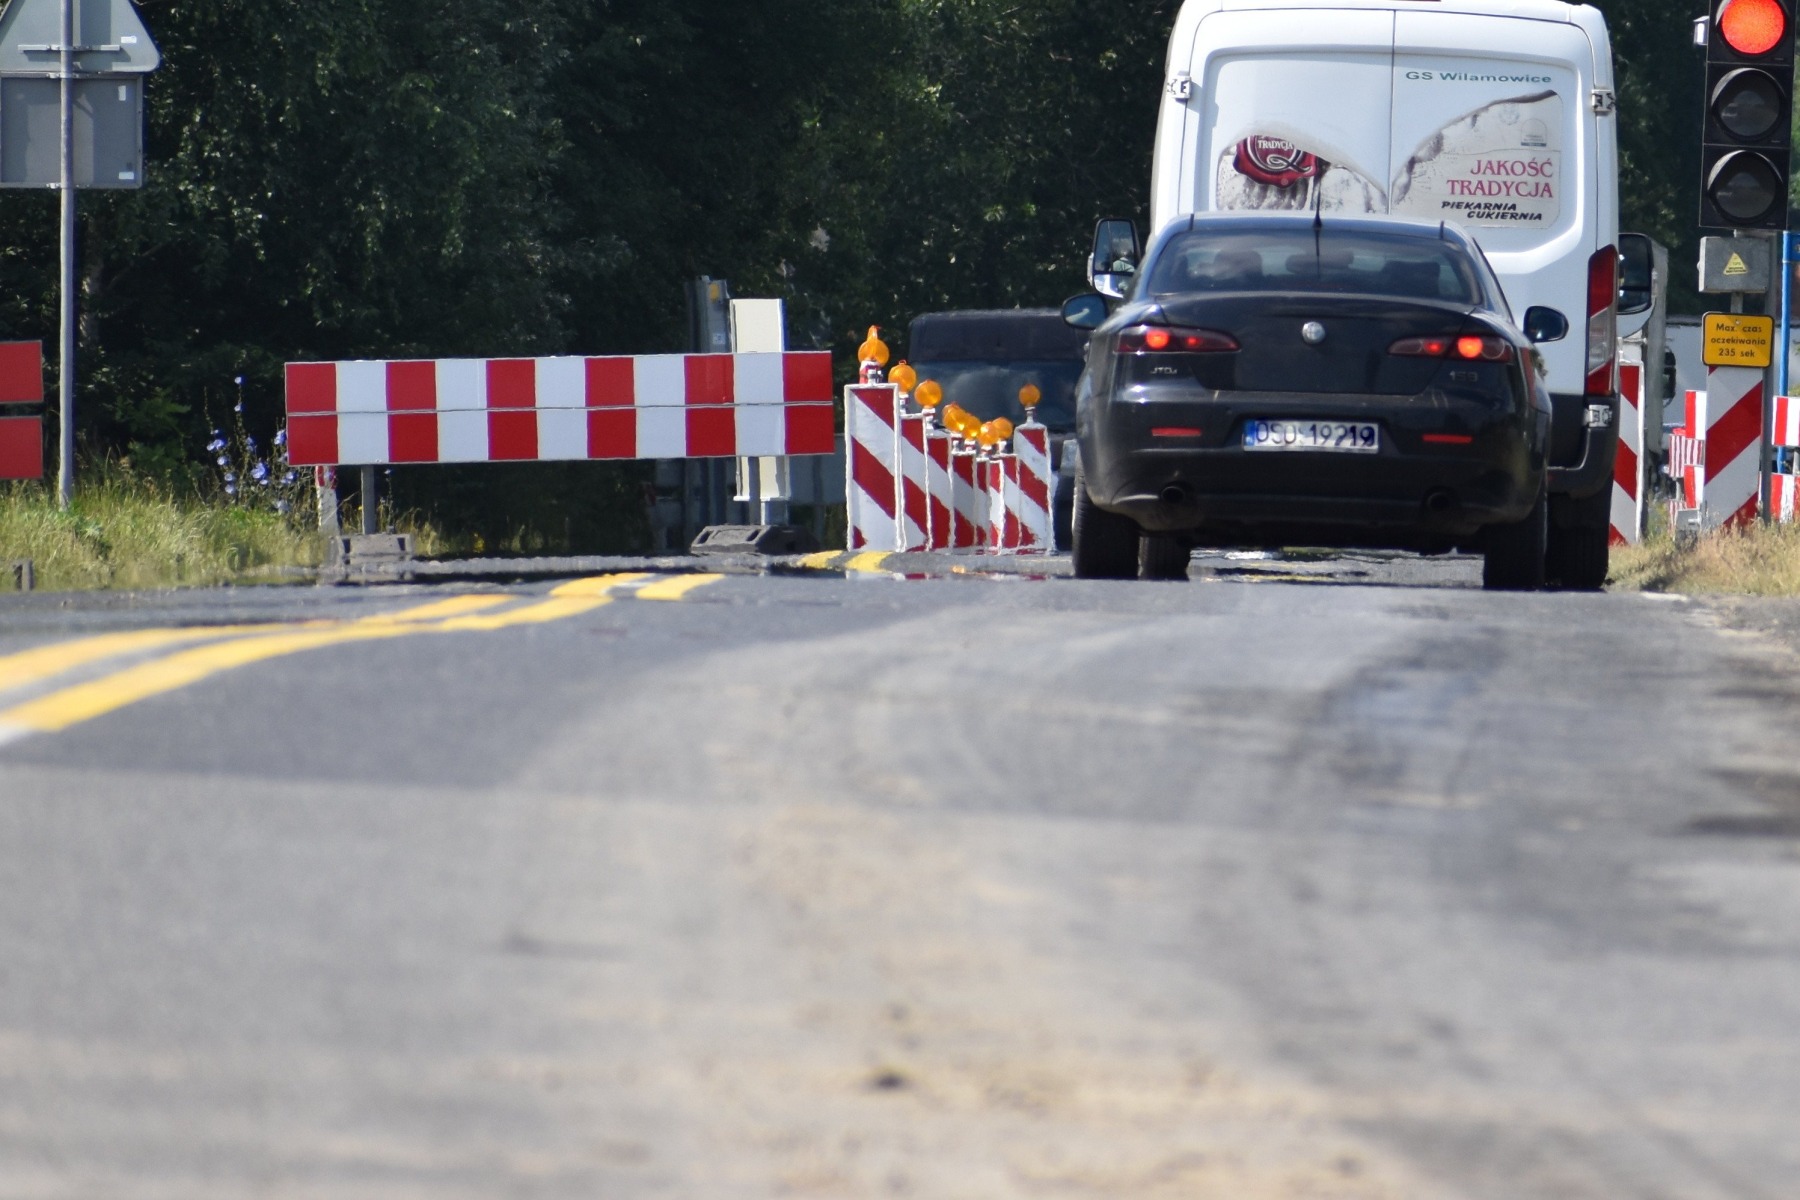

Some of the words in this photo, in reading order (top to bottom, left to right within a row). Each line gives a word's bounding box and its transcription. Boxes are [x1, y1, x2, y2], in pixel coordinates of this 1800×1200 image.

[1405, 71, 1433, 81] GS
[1440, 72, 1552, 83] Wilamowice
[1258, 139, 1294, 151] TRADYCJA
[1470, 157, 1554, 178] JAKOŚĆ
[1446, 179, 1554, 198] TRADYCJA
[1440, 200, 1517, 211] PIEKARNIA
[1467, 210, 1543, 221] CUKIERNIA
[1710, 336, 1766, 345] oczekiwania
[1718, 348, 1736, 357] 235
